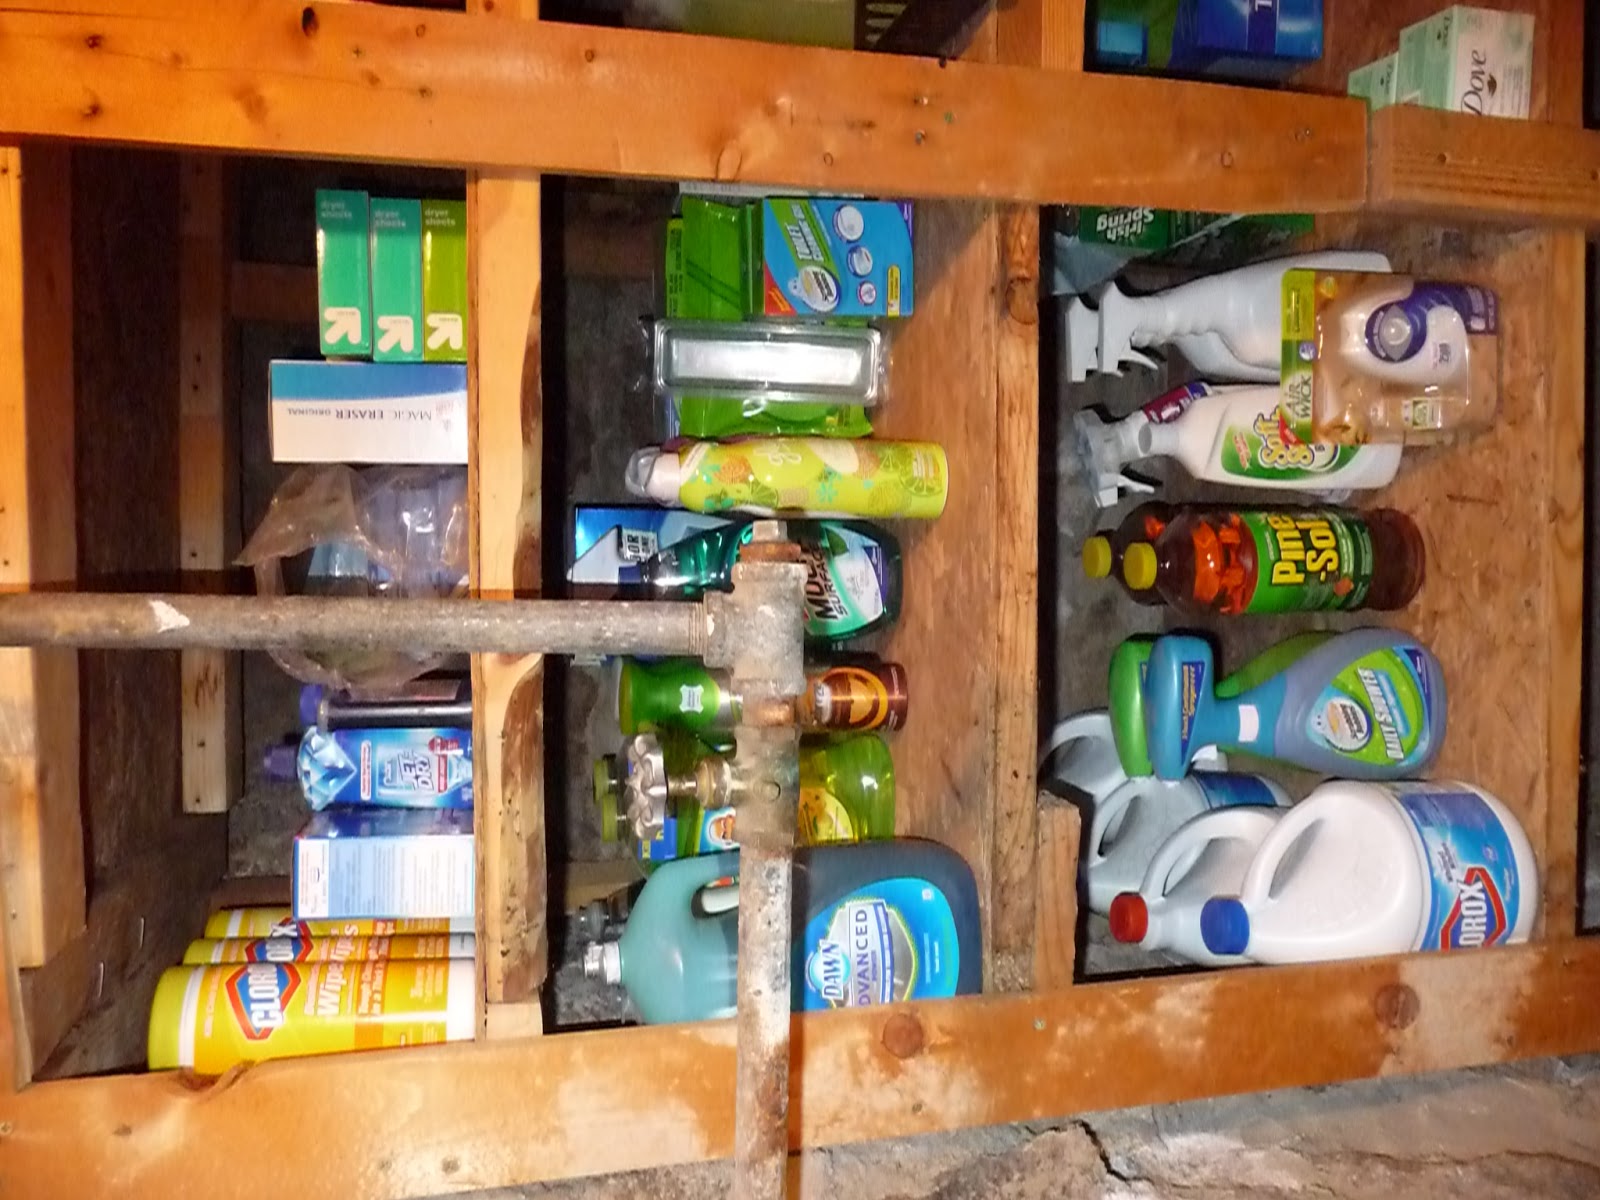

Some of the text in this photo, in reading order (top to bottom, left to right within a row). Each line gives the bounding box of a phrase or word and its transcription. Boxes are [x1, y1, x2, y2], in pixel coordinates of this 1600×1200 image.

[1460, 49, 1487, 115] Dove
[784, 222, 813, 260] TOILET
[1096, 206, 1154, 232] Spring
[1106, 220, 1143, 241] Irish
[287, 407, 432, 421] MAGIC ERASER ORIGINAL
[1300, 375, 1311, 418] WICK
[1267, 514, 1306, 584] Pine
[1296, 520, 1339, 582] -Sol
[1357, 667, 1394, 724] SHOWER
[1378, 722, 1405, 759] DAILY
[1456, 879, 1488, 946] OROX
[820, 940, 842, 998] DAWN
[855, 909, 871, 1006] DVANCED
[247, 963, 283, 1028] CLORO
[316, 963, 347, 1015] Wipe
